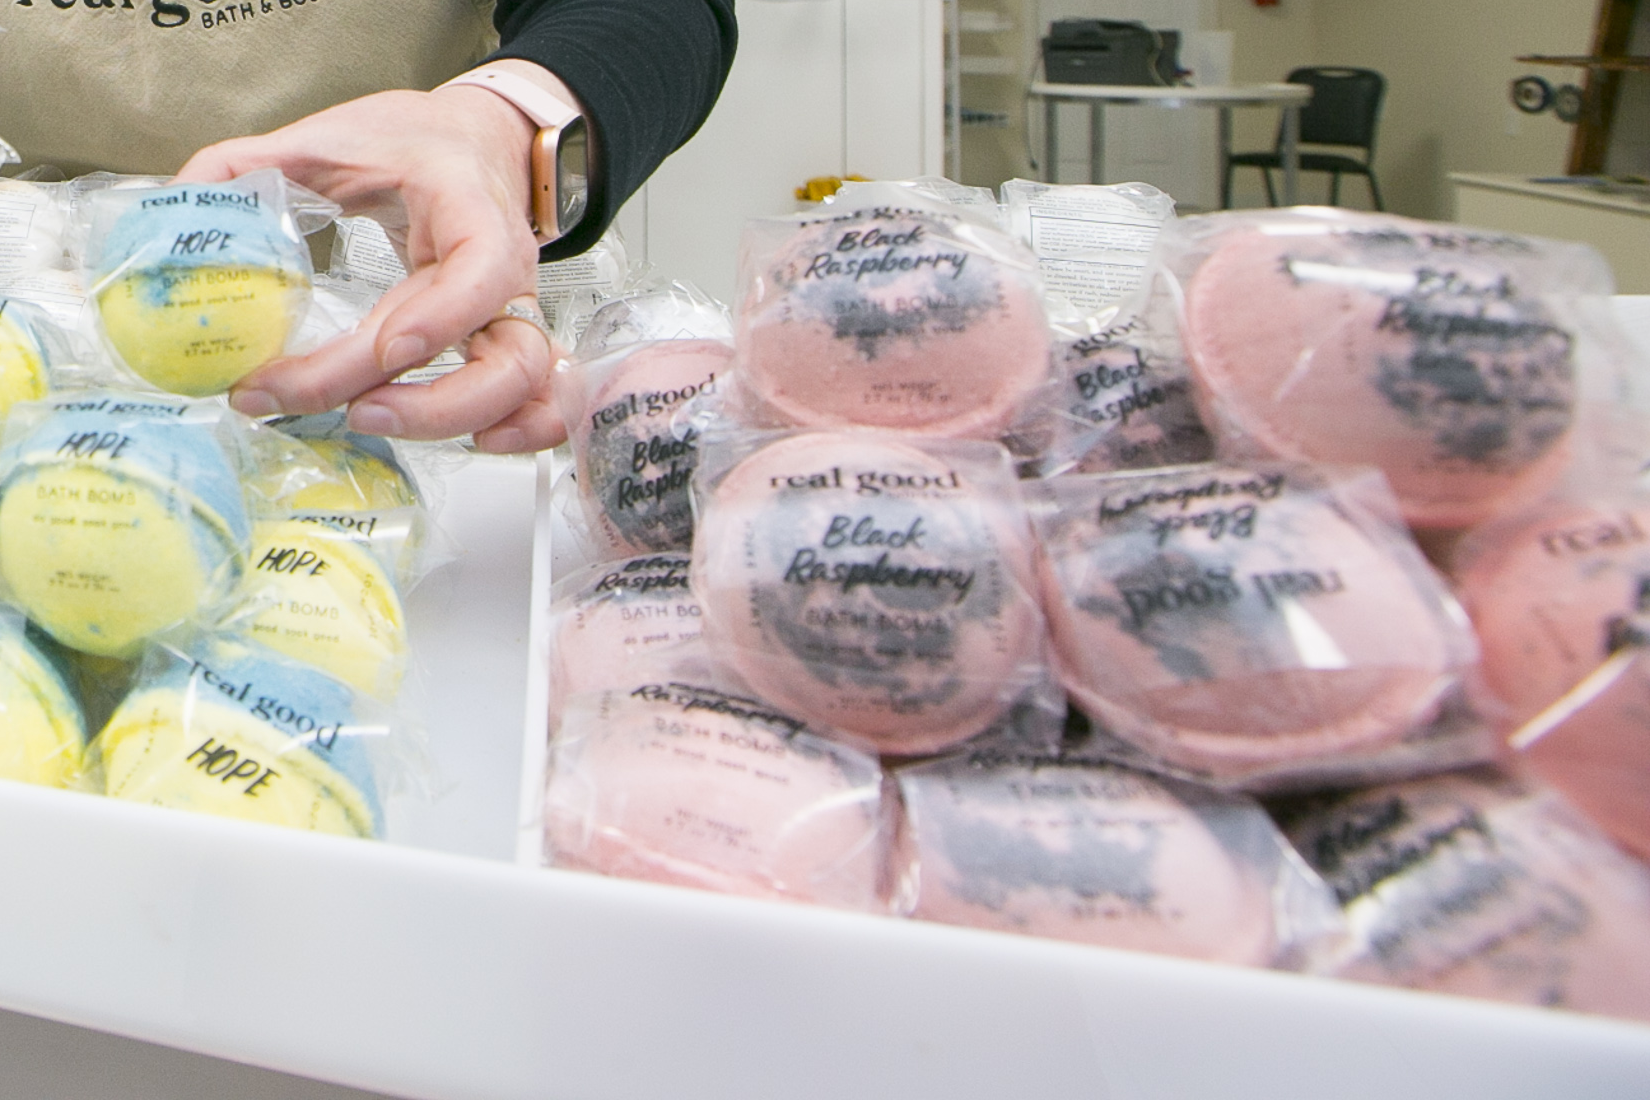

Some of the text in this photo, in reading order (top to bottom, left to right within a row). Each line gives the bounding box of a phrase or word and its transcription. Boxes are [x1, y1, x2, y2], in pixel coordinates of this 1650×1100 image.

[201, 2, 255, 29] BATH
[140, 189, 260, 210] real good
[169, 229, 237, 256] HOPE
[835, 225, 927, 252] Black
[162, 269, 251, 290] BATH BOMB
[803, 249, 968, 283] Raspberry
[591, 372, 718, 430] real good
[55, 430, 134, 461] HOPE
[631, 427, 699, 473] Black
[36, 486, 137, 506] BATH BOMB
[769, 466, 962, 497] real good
[821, 513, 928, 550] Black
[256, 547, 331, 577] HOPE
[783, 548, 977, 606] Raspberry
[289, 602, 340, 620] BOMB
[621, 604, 703, 621] BATH BO
[187, 661, 343, 752] real good
[185, 737, 282, 797] HOPE
